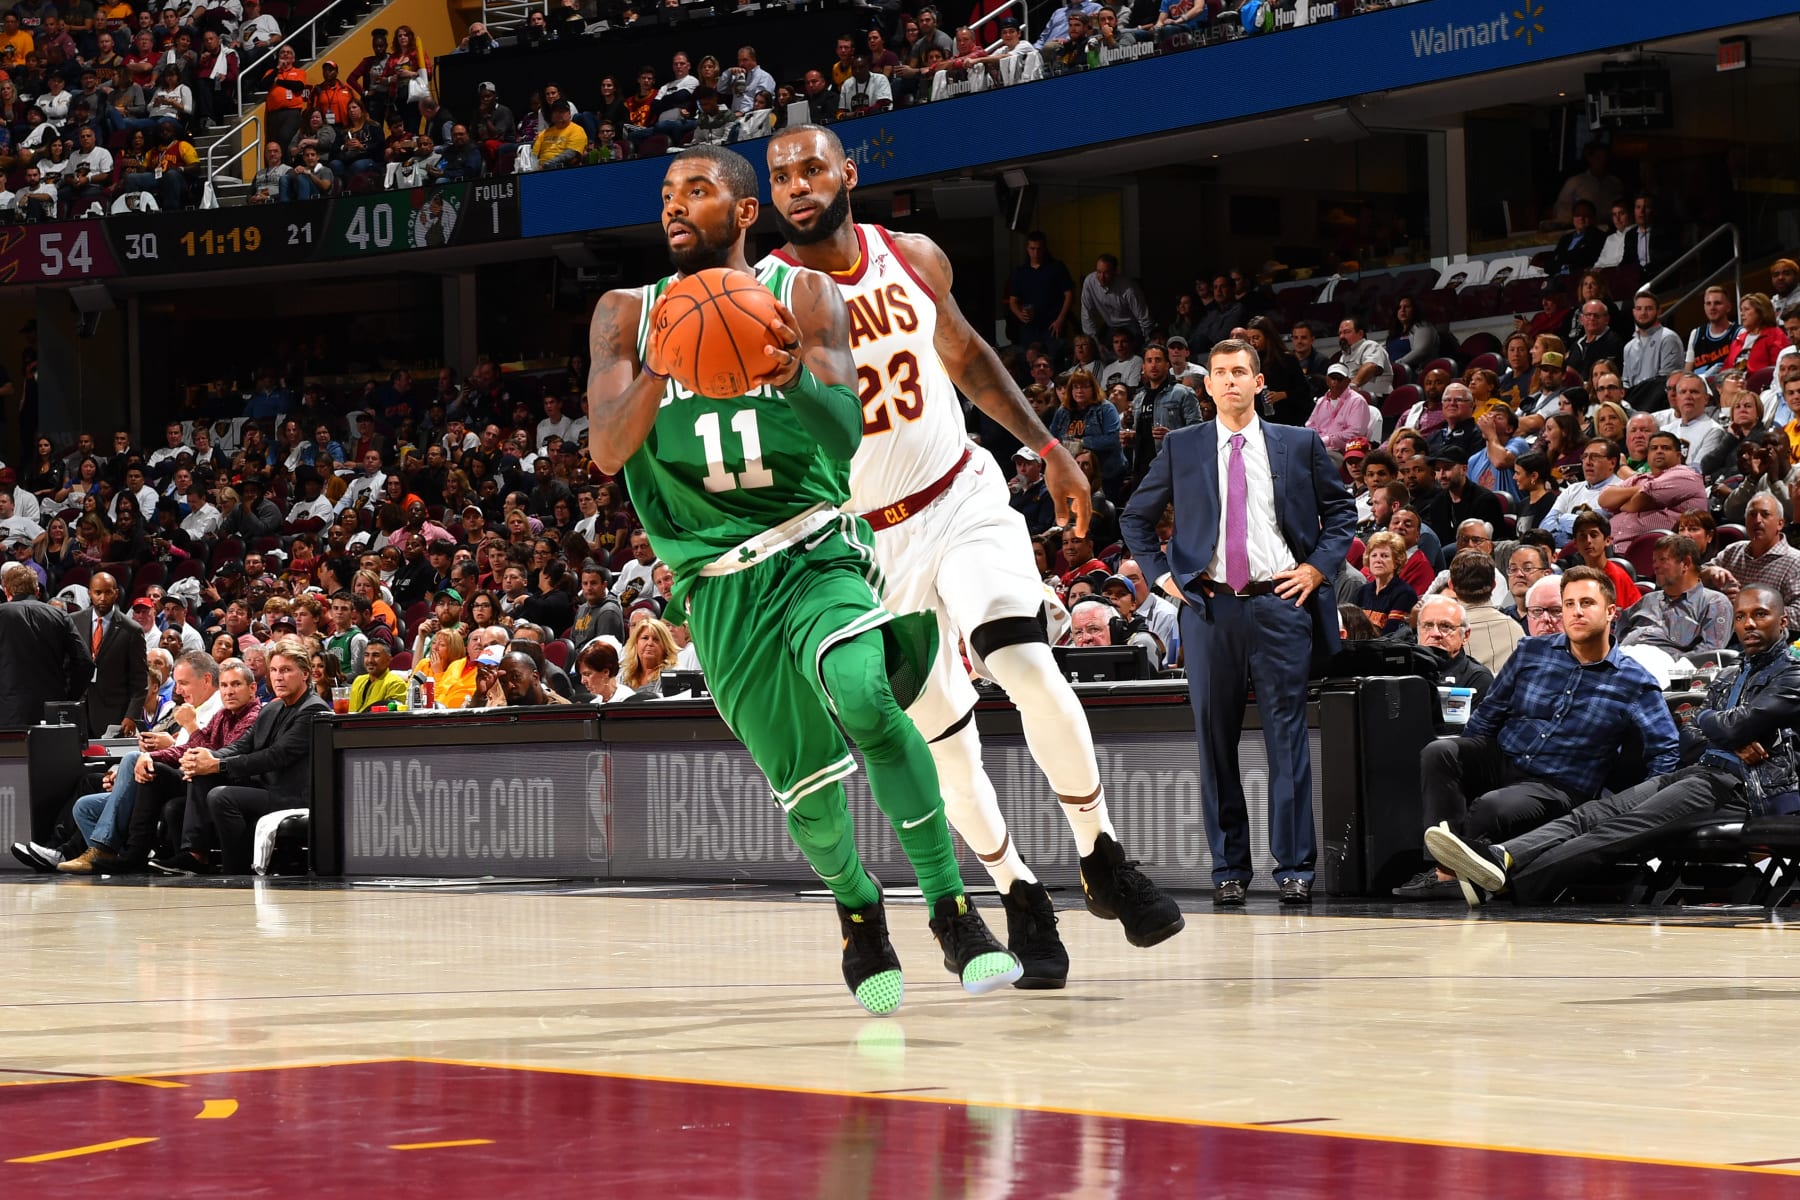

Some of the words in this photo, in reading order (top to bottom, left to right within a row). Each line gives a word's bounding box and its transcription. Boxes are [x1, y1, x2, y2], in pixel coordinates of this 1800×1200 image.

[1275, 2, 1335, 27] Hungton
[1411, 11, 1510, 58] Walmart
[475, 182, 514, 202] FOULS
[287, 222, 312, 245] 21
[345, 203, 393, 250] 40
[491, 201, 500, 234] 1
[39, 230, 93, 276] 54
[125, 232, 159, 259] 3Q
[179, 226, 262, 257] 11:19
[845, 283, 919, 349] AVS
[856, 349, 924, 438] 23
[694, 408, 774, 494] 11
[884, 502, 909, 524] CLE
[353, 758, 555, 859] NBAStore.com
